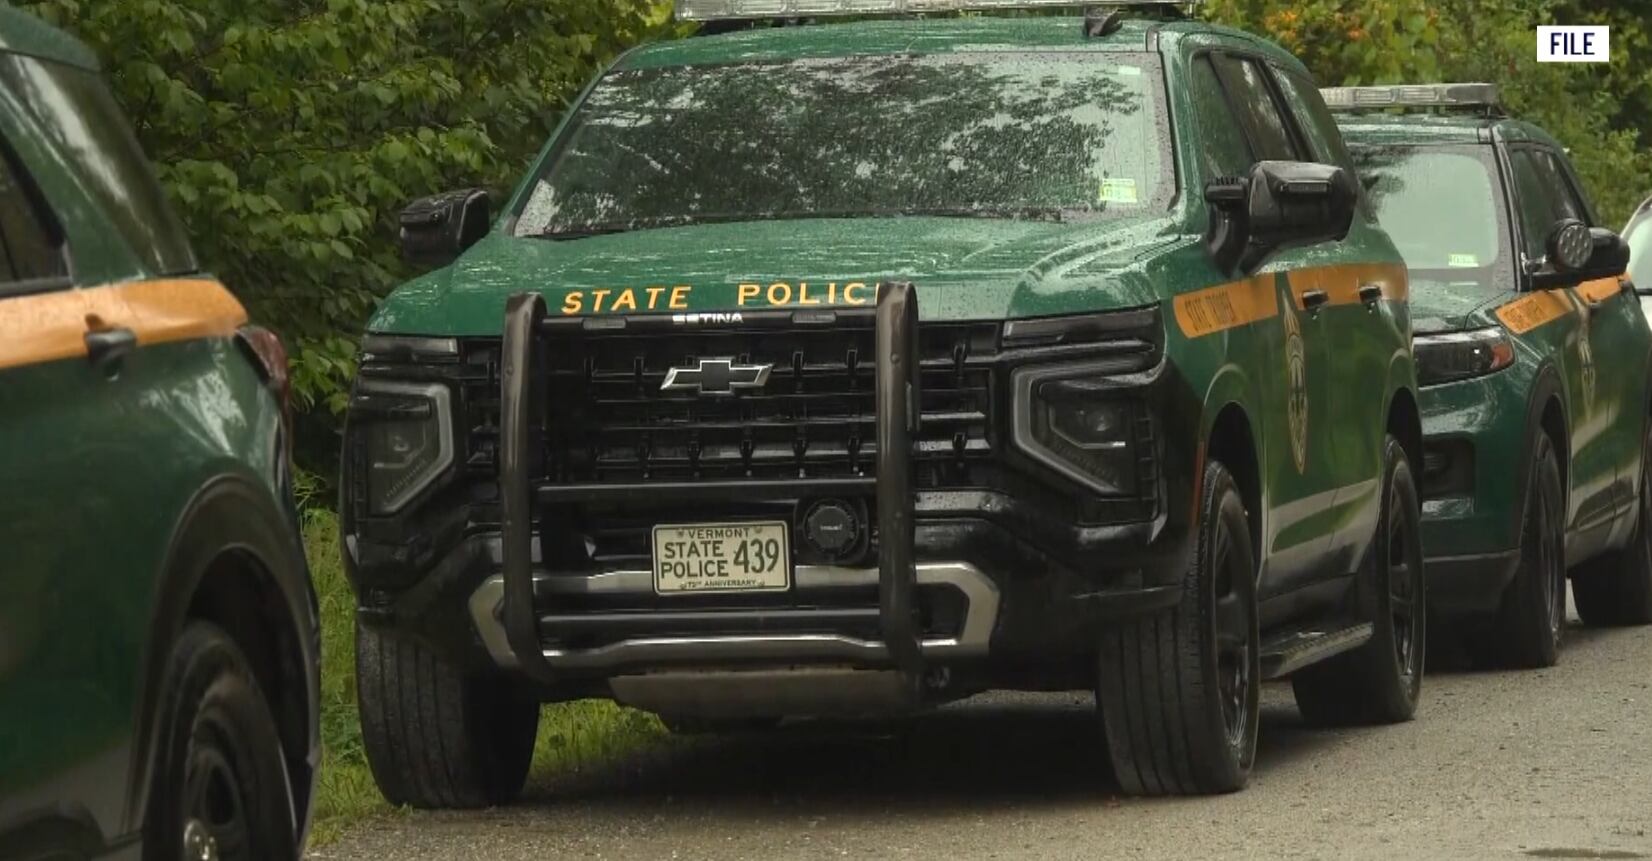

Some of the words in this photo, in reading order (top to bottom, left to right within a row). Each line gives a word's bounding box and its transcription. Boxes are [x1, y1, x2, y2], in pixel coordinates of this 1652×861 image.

[561, 286, 692, 314] STATE
[737, 281, 881, 306] POLIC
[688, 527, 751, 539] VERMONT
[664, 540, 724, 559] STATE
[733, 538, 780, 574] 439
[660, 560, 729, 579] POLICE
